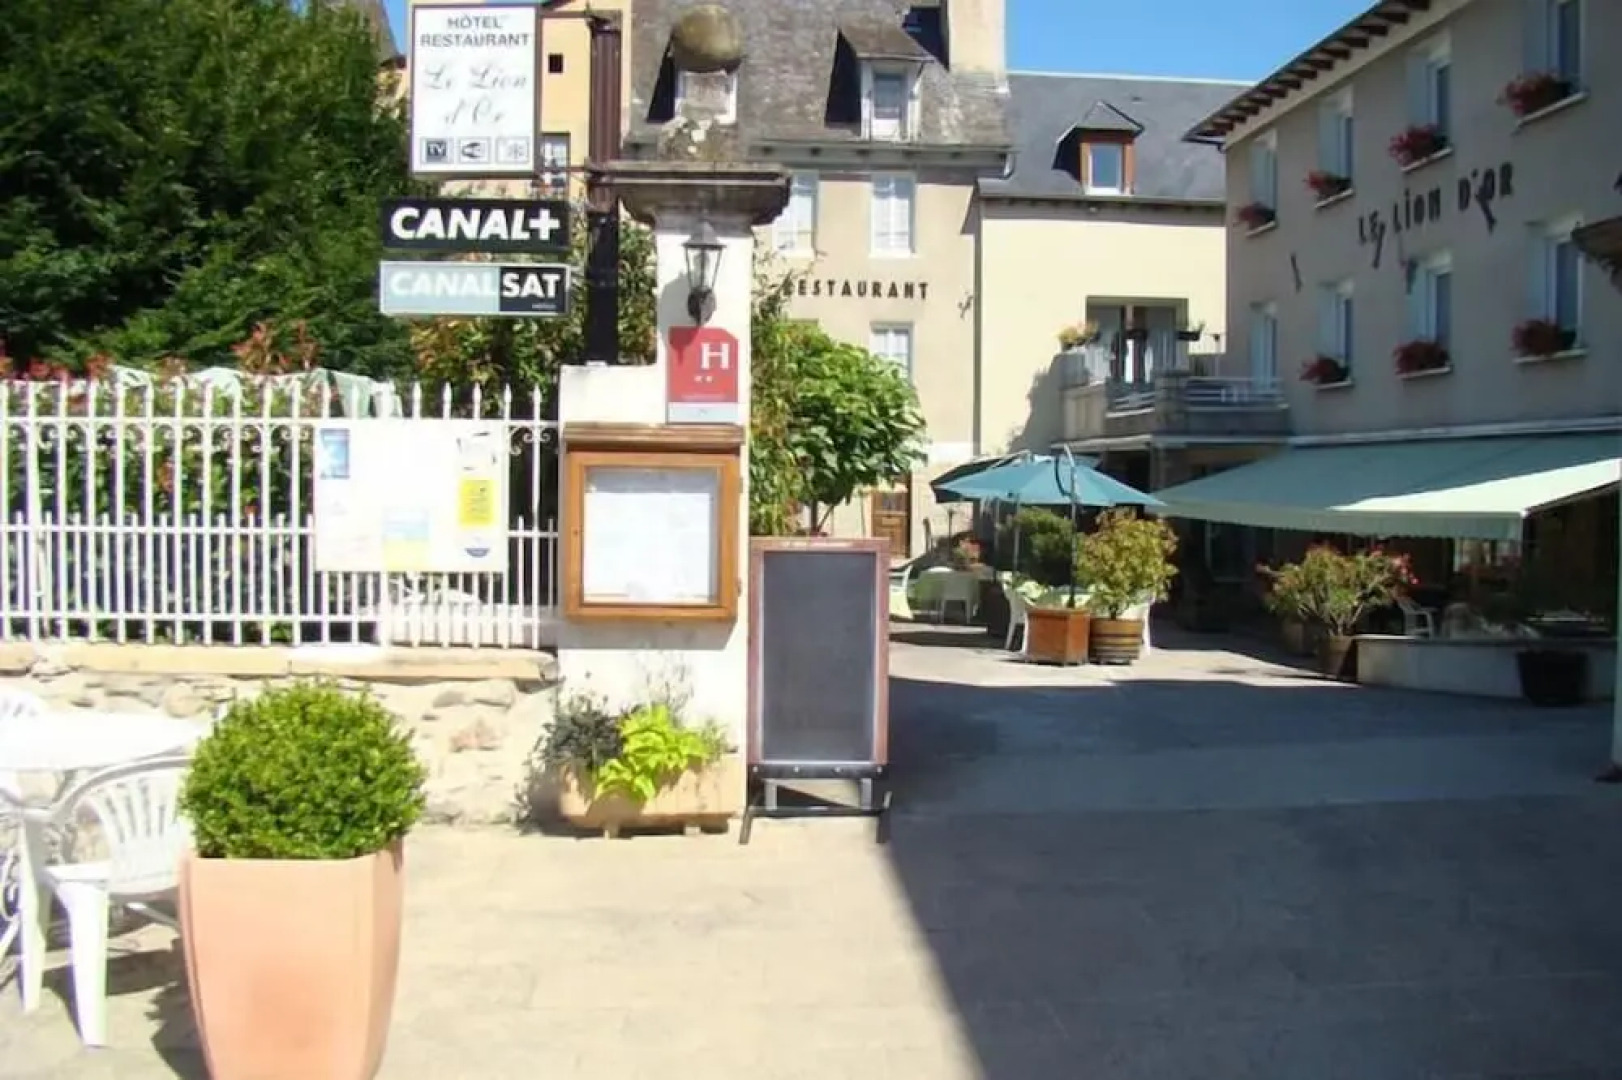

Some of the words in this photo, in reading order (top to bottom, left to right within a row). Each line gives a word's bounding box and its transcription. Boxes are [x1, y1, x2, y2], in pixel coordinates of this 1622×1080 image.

[420, 33, 530, 48] RESTAURANT
[390, 207, 560, 240] CANAL+
[1358, 210, 1381, 244] LE
[701, 342, 729, 370] H
